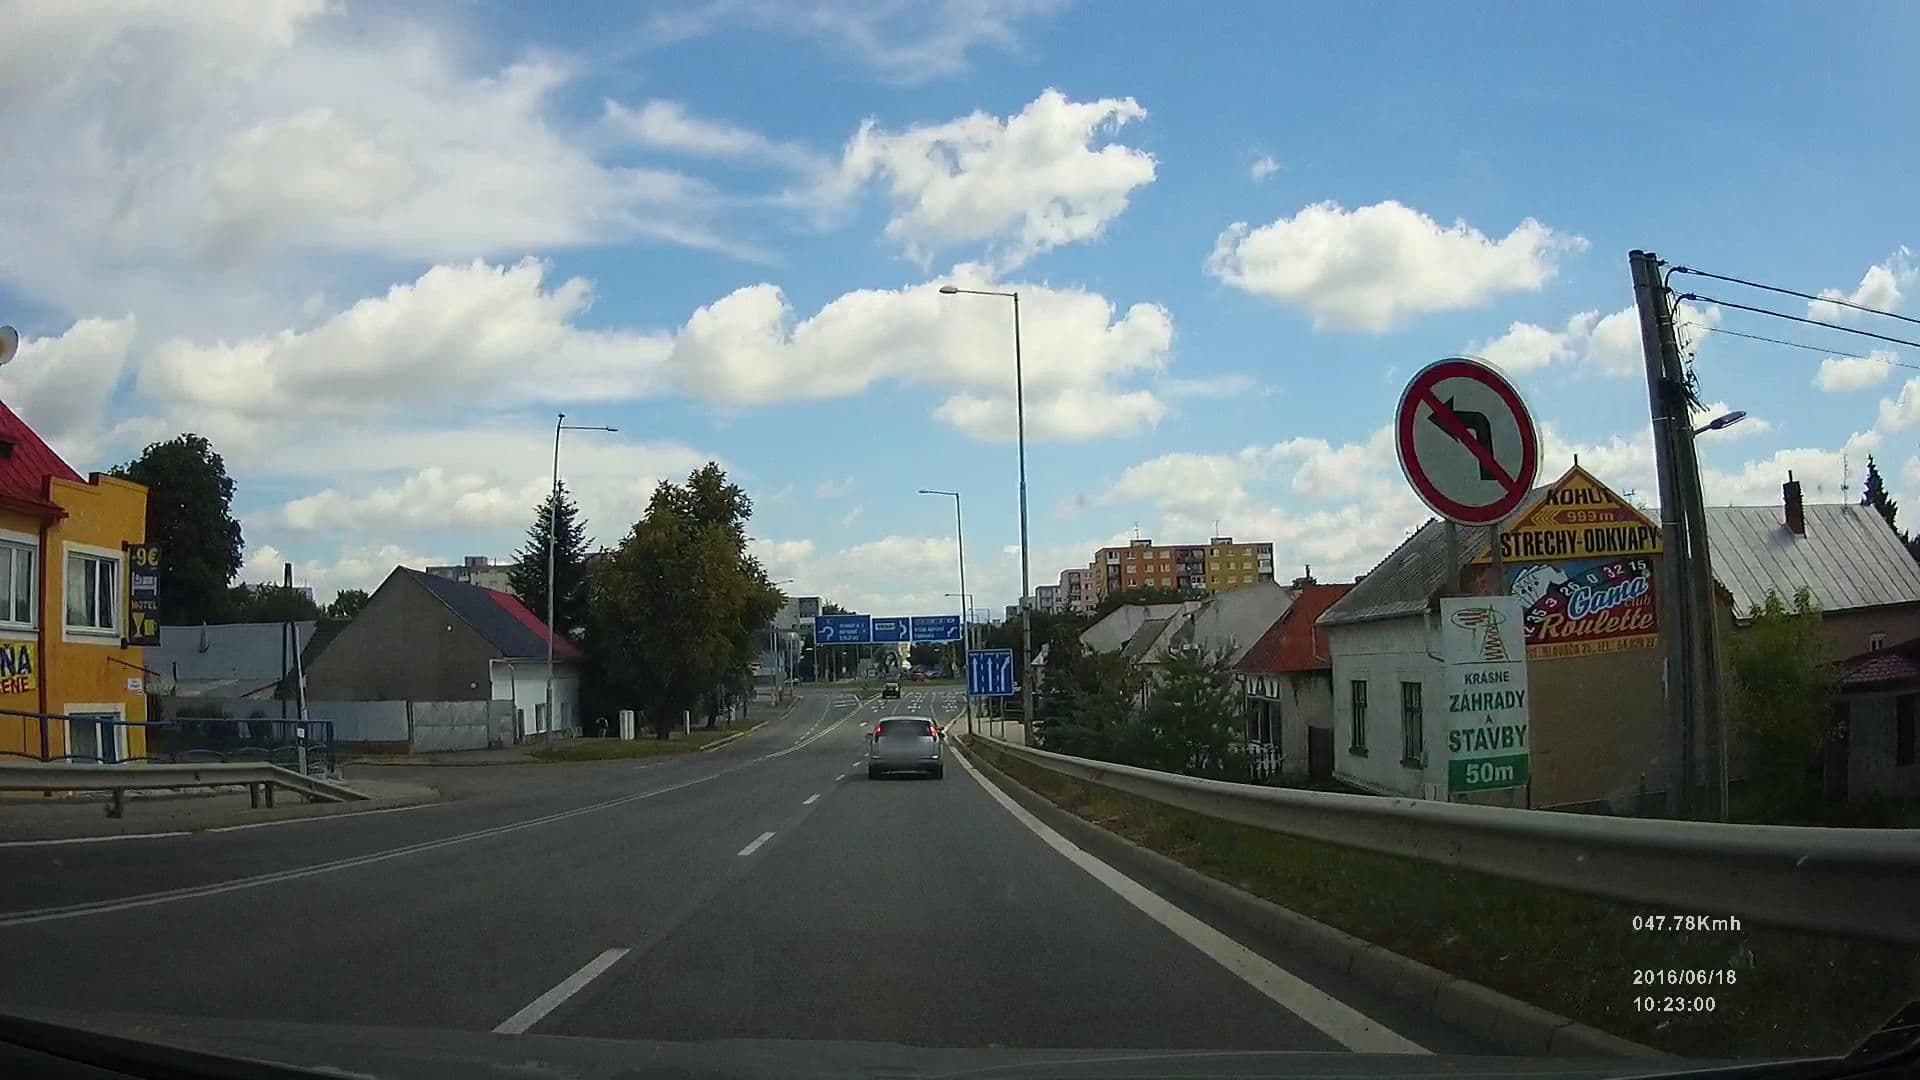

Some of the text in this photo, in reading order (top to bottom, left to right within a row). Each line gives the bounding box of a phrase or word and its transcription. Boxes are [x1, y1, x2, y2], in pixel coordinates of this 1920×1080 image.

[1567, 510, 1615, 522] 999 m
[1501, 526, 1658, 558] STRECHY-ODKVAPY
[1604, 564, 1625, 578] 32
[1629, 559, 1646, 570] 15
[1567, 577, 1649, 620] Gama
[1538, 609, 1656, 641] Roulette
[0, 676, 29, 695] ENE
[1449, 689, 1526, 713] ZÁHRADY
[1485, 714, 1494, 725] A
[1449, 725, 1528, 754] STAVBY
[1465, 762, 1514, 784] 50m
